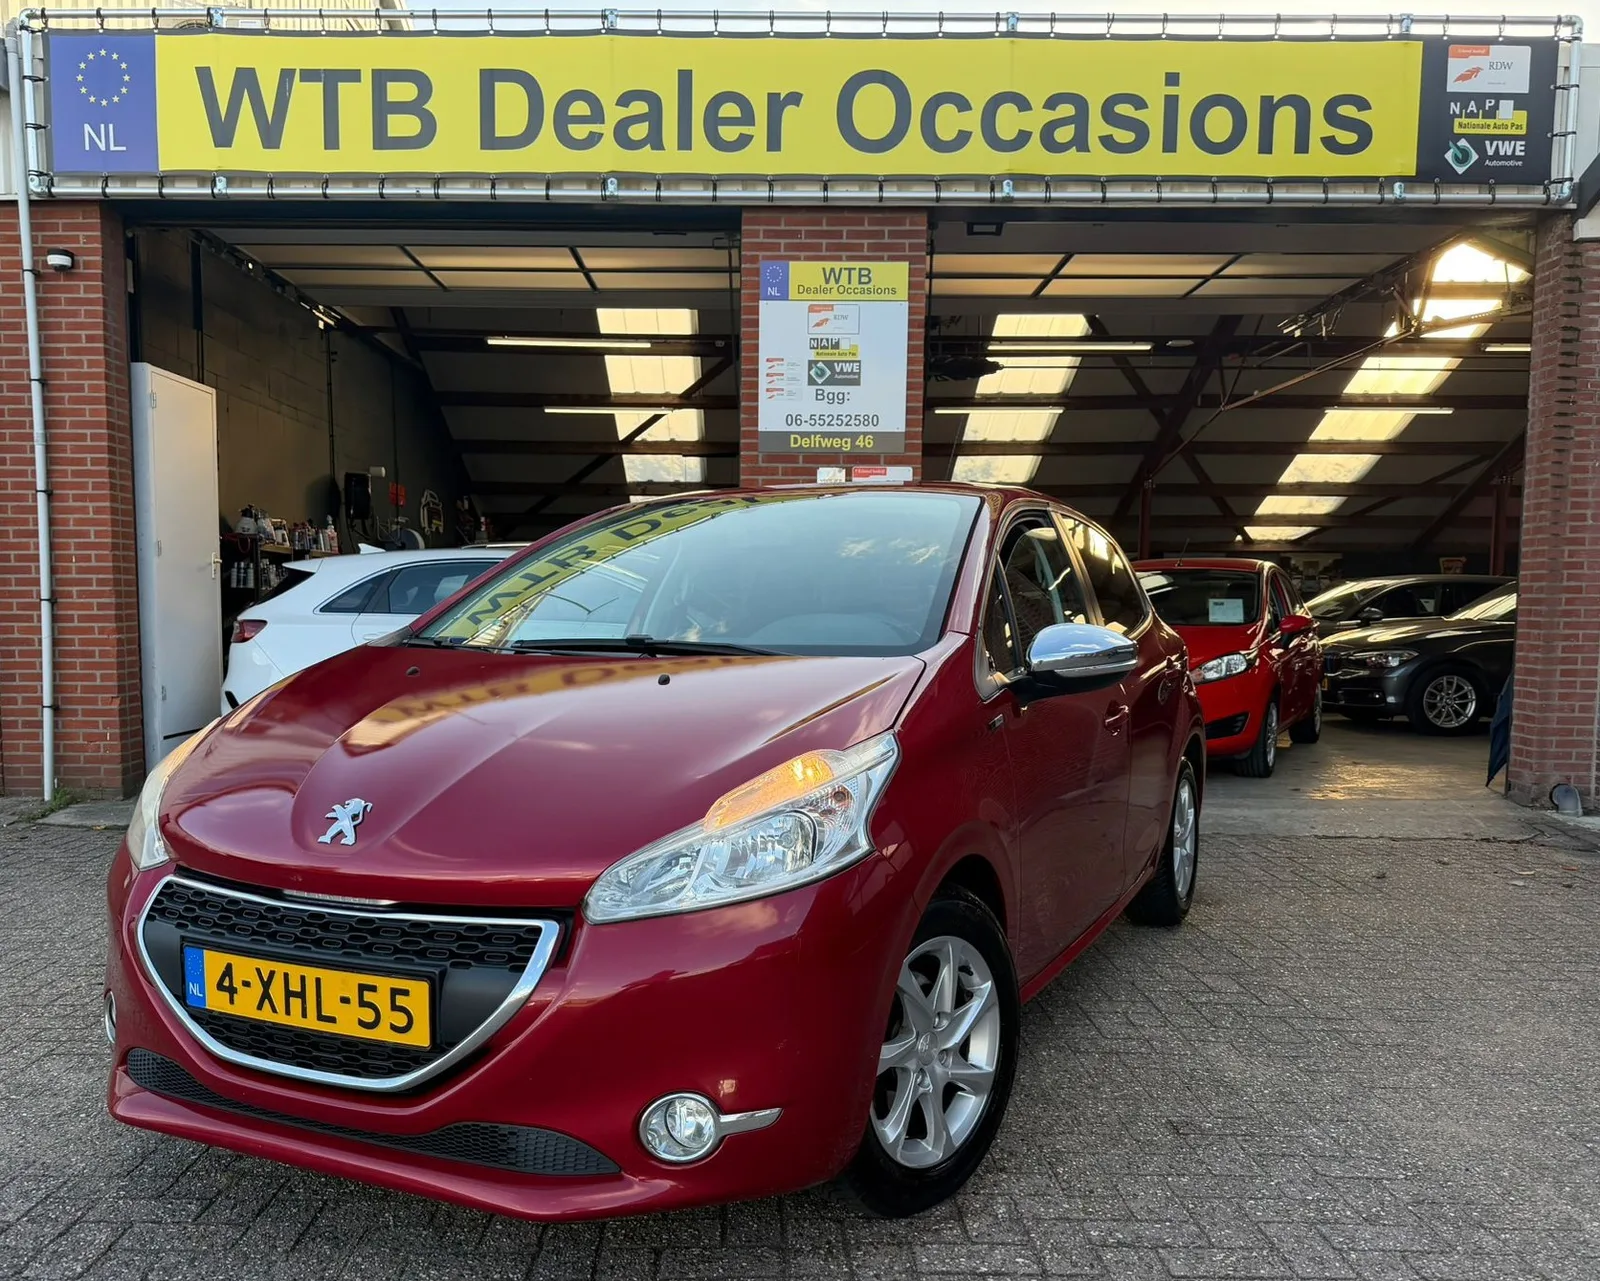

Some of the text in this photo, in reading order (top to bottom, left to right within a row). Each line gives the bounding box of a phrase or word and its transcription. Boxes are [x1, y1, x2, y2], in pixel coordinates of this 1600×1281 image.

[1488, 61, 1513, 71] RDW
[194, 65, 1374, 155] WTB Dealer Occasions
[1457, 121, 1524, 131] Nationale Auto Pas
[83, 123, 127, 152] NL
[1484, 140, 1526, 156] VWE
[1484, 159, 1523, 167] Automotive
[822, 266, 872, 286] WTB
[767, 286, 781, 296] NL
[797, 284, 897, 296] Dealer Occasions
[834, 362, 860, 373] VWE
[815, 388, 851, 405] Bgg:
[785, 413, 880, 427] 06-55252580
[790, 434, 874, 450] Delfweg 46
[188, 981, 204, 998] NL
[215, 962, 415, 1034] 4-XHL-55
